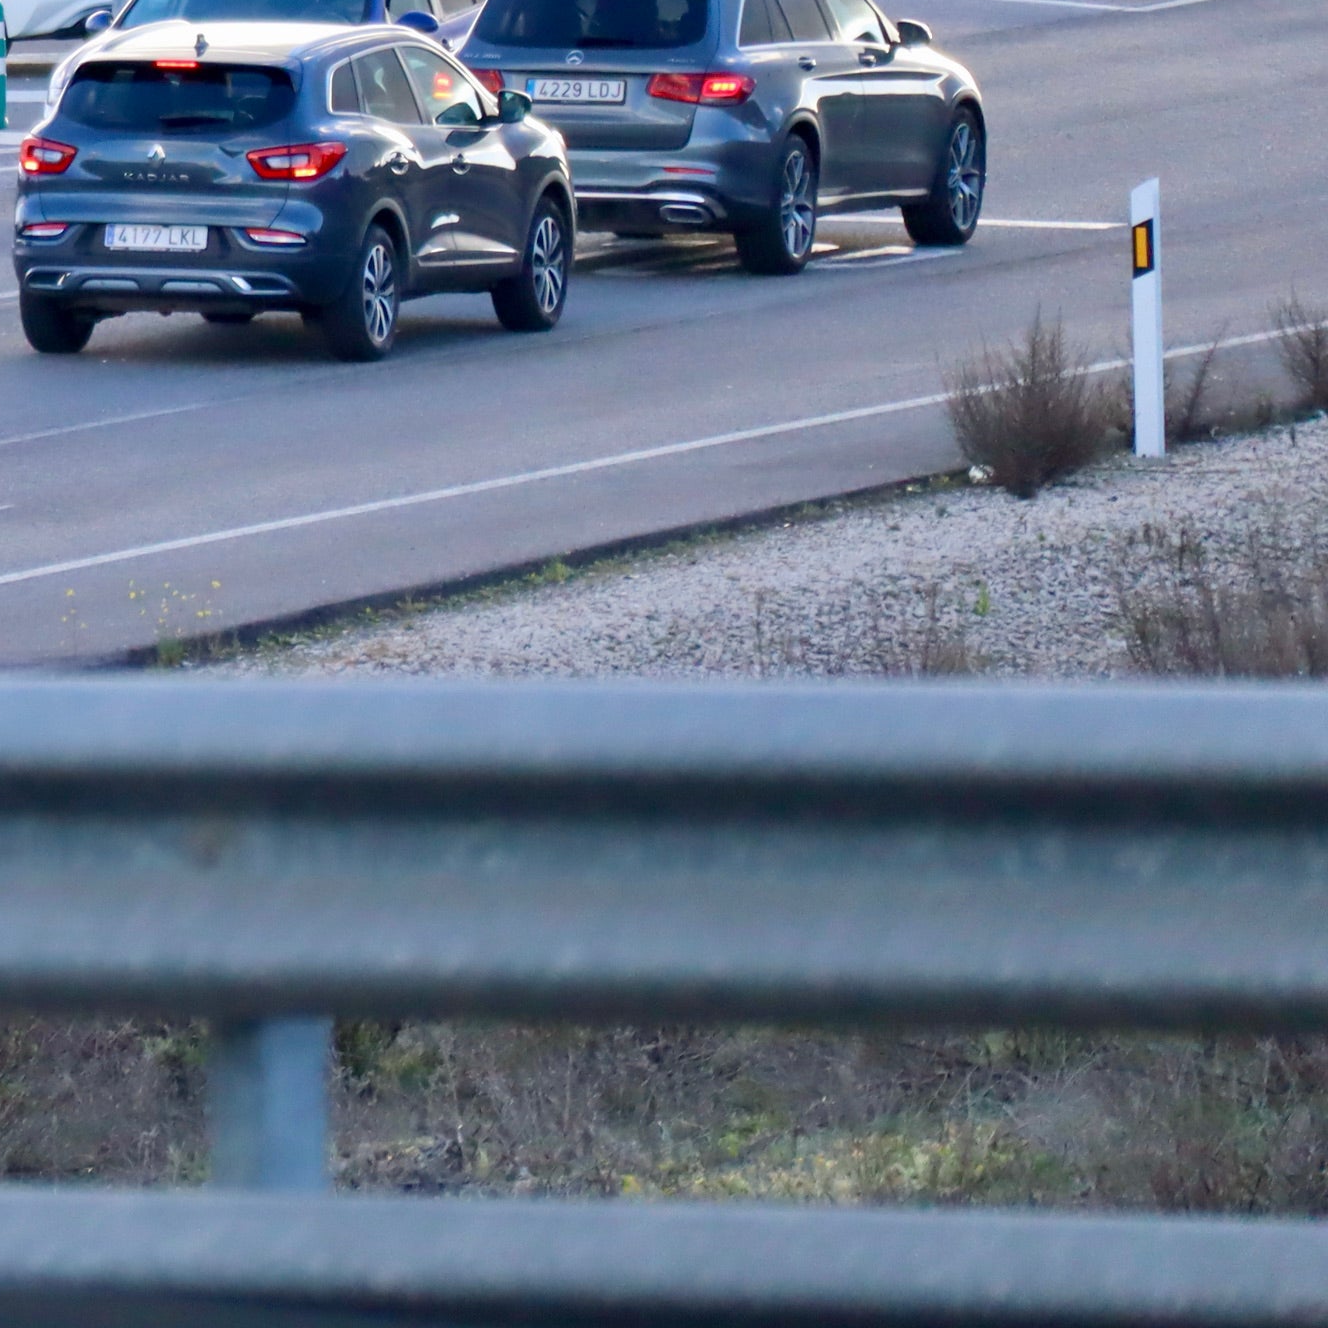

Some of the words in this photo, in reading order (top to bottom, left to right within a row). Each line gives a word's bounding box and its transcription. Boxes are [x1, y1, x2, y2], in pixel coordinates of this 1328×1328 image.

[538, 80, 583, 98] 4229
[588, 82, 623, 99] LDJ
[123, 172, 190, 182] KADJAR
[118, 226, 162, 244] 4177
[169, 227, 201, 246] LKL
